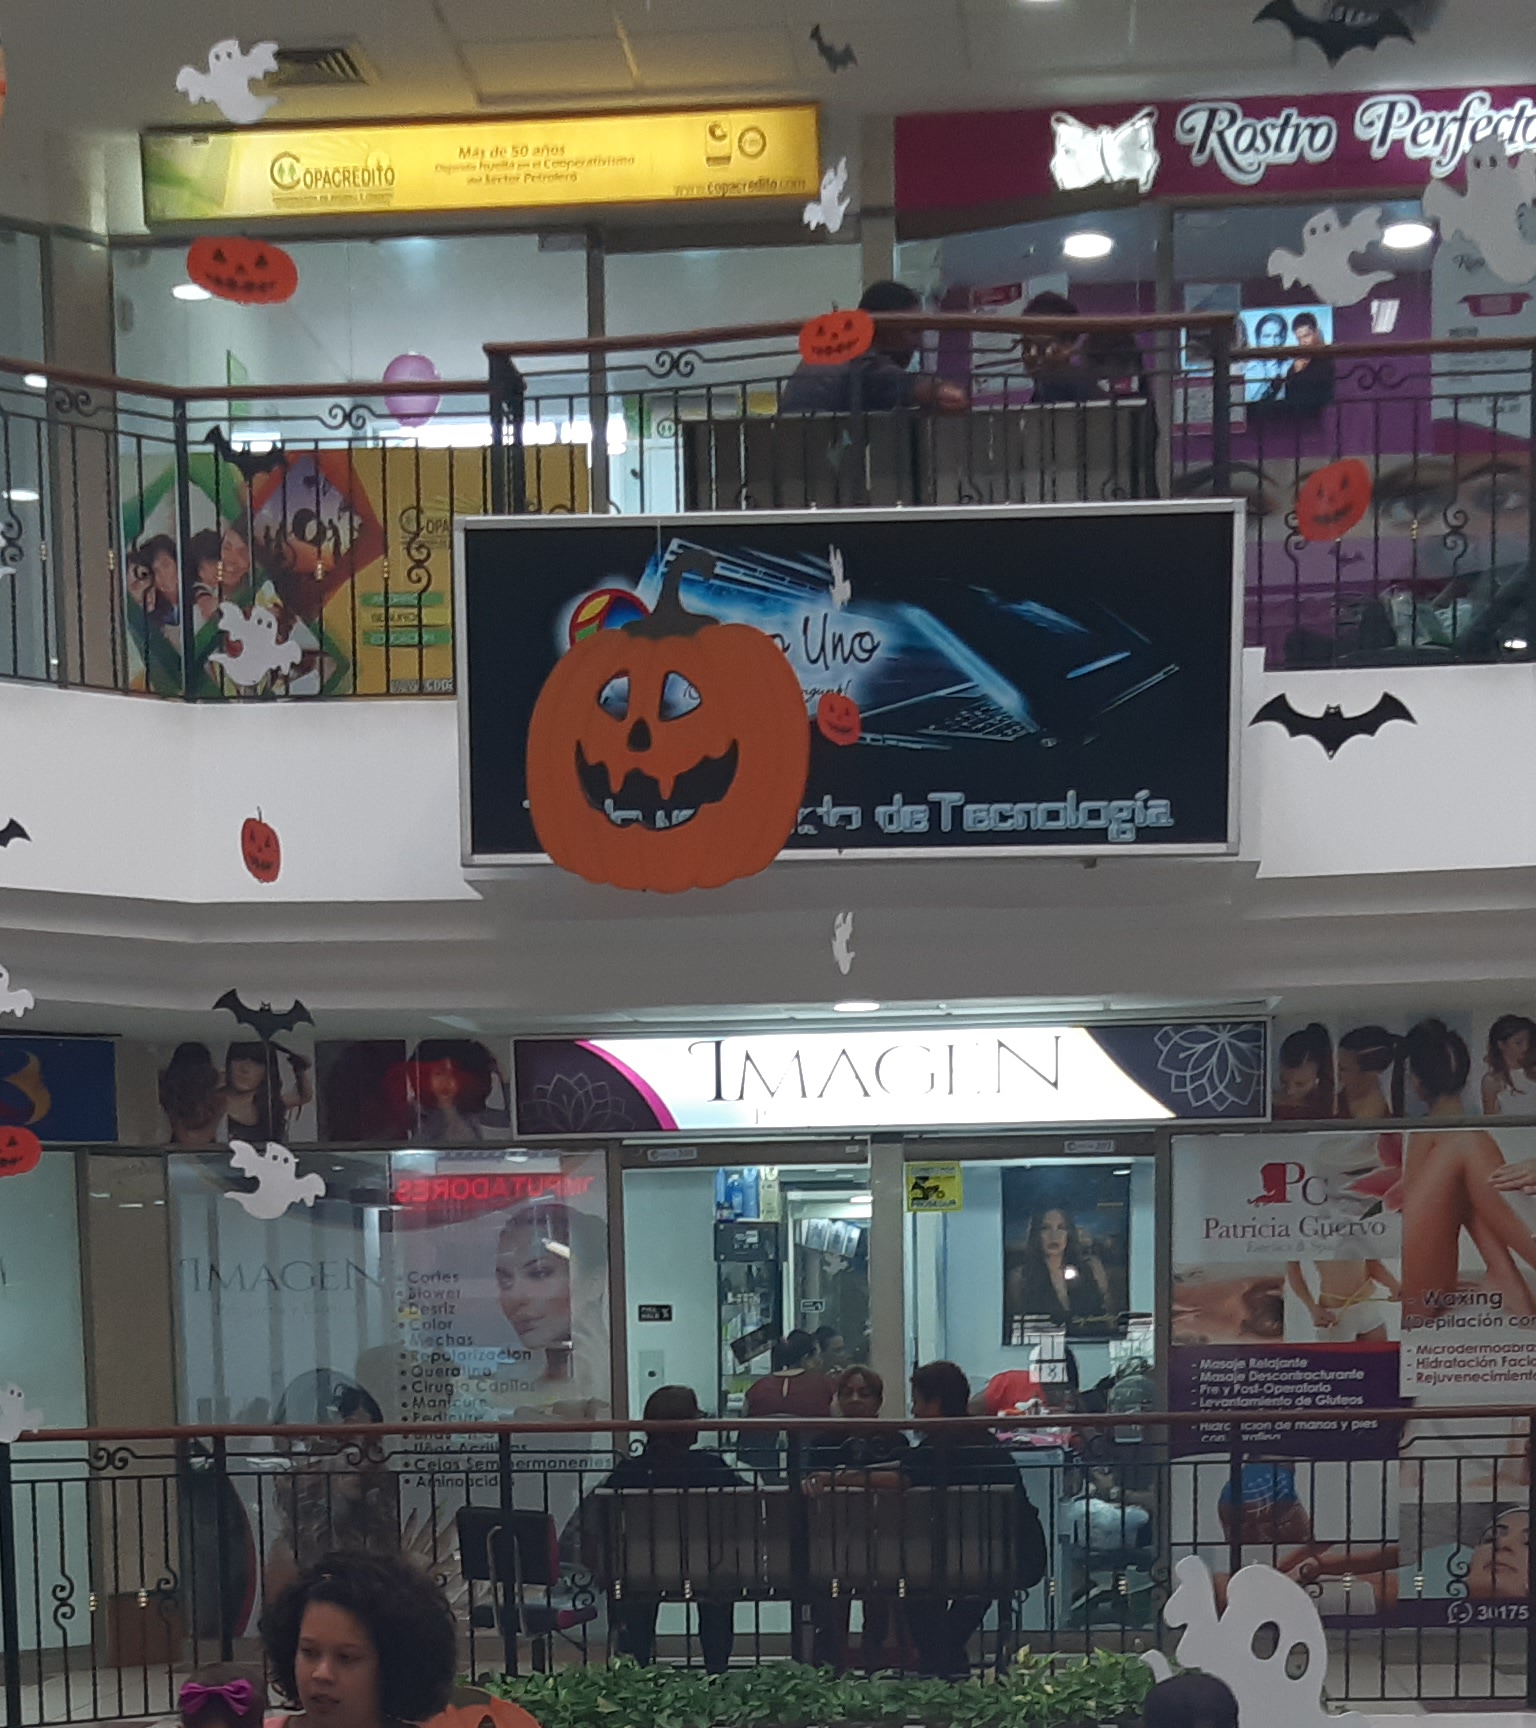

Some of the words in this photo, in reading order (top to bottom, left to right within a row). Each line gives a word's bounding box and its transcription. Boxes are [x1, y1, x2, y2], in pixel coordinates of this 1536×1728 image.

[1176, 101, 1336, 184] Rostro
[803, 612, 881, 672] Uno
[1203, 1217, 1291, 1239] Patricia
[179, 1257, 386, 1292] IMAGEN
[1423, 1290, 1503, 1310] Waxing
[1199, 1358, 1246, 1371] Masaje
[1199, 1371, 1246, 1384] Masaje
[1295, 1397, 1312, 1406] de
